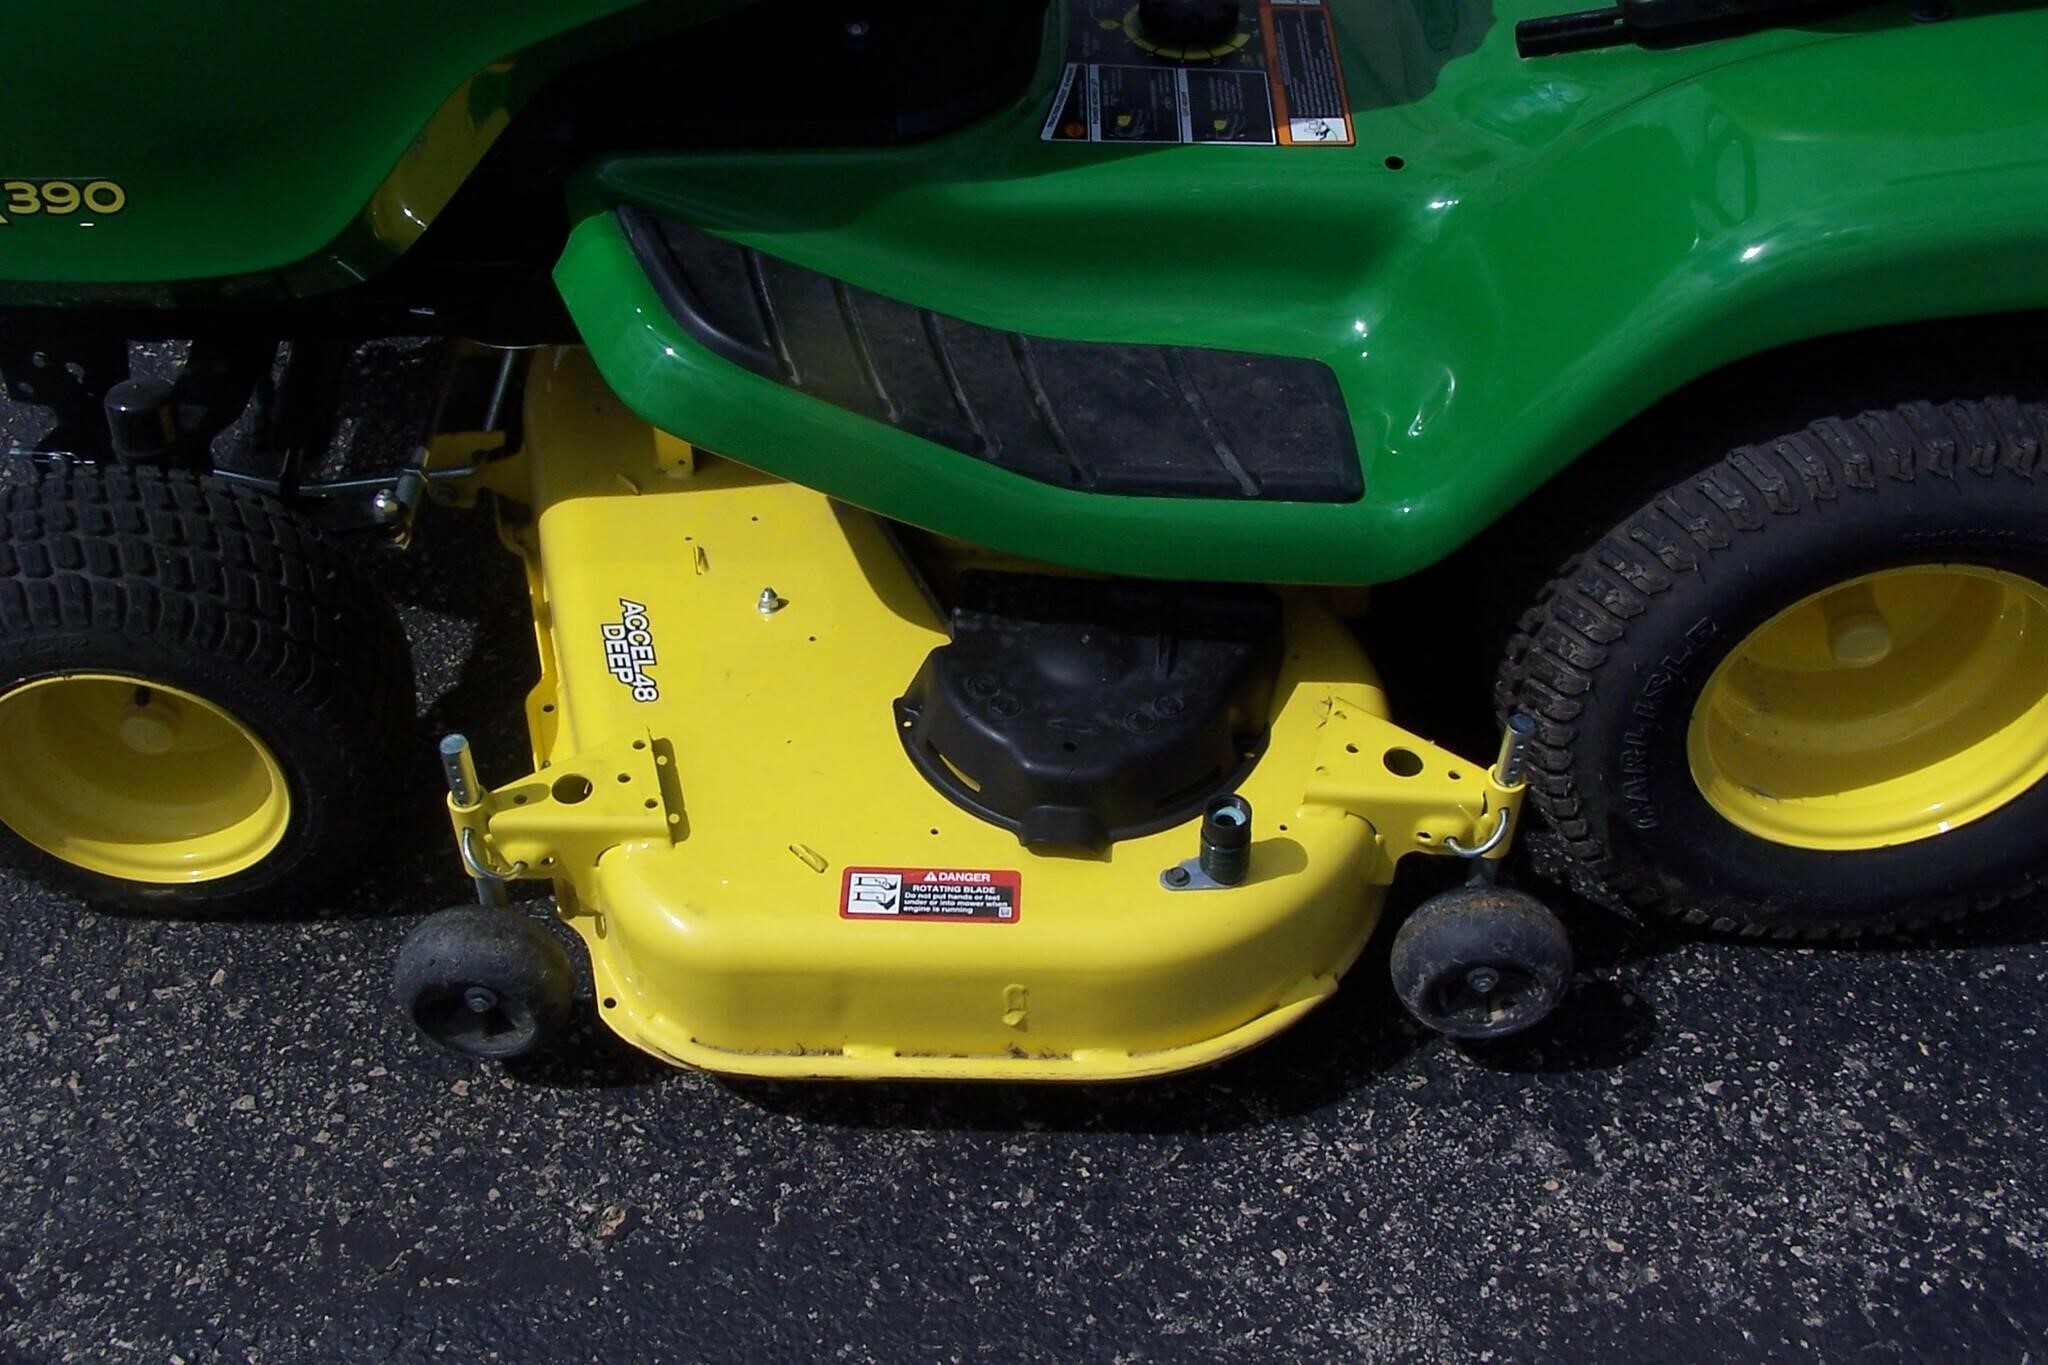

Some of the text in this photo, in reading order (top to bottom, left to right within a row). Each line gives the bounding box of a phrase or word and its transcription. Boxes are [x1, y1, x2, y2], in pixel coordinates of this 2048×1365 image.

[0, 180, 126, 223] 390
[601, 624, 635, 686] DEEP
[912, 885, 996, 894] ROTATING BLADE
[938, 872, 991, 882] DANGER
